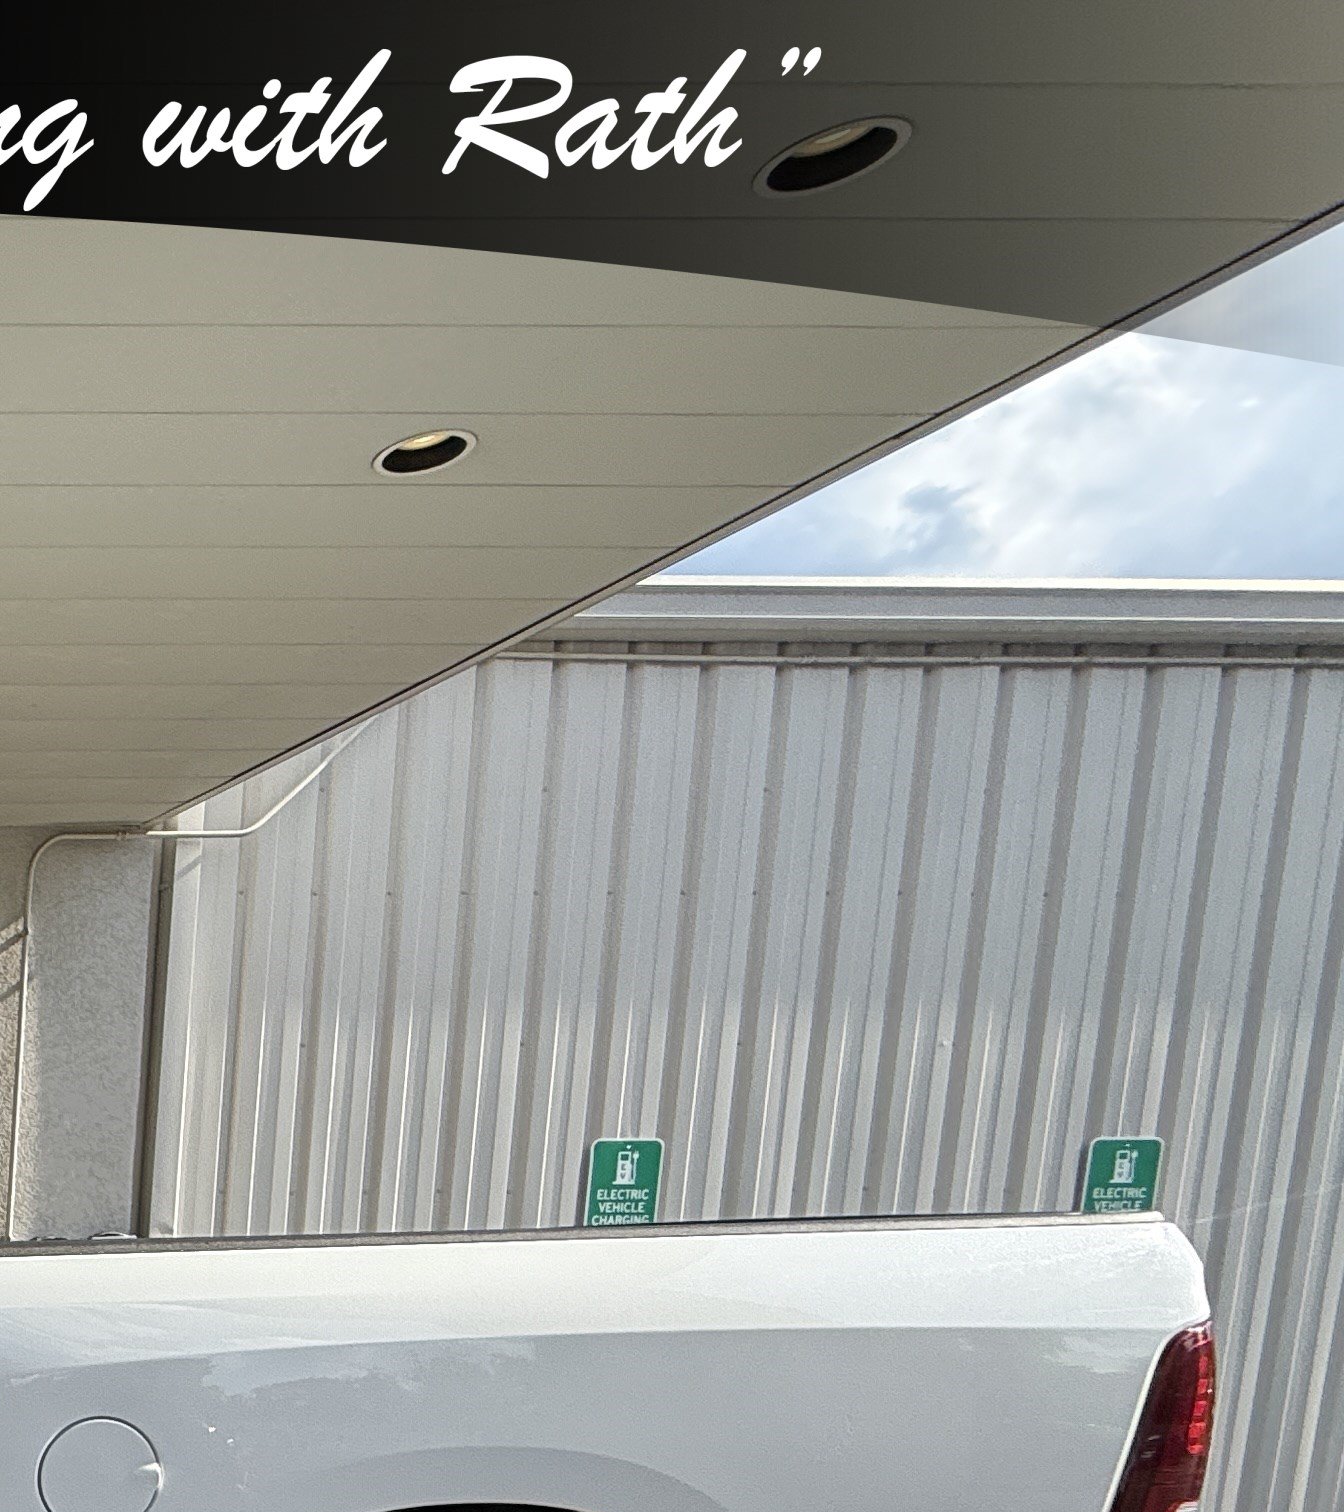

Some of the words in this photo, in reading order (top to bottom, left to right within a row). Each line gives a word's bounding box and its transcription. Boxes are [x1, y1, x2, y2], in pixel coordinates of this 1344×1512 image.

[596, 1188, 649, 1200] ELECTRIC
[1093, 1187, 1147, 1199] ELECTRIC
[598, 1201, 647, 1213] VEHICLE
[1094, 1200, 1142, 1212] VEHICLE
[592, 1214, 649, 1226] CHARGING
